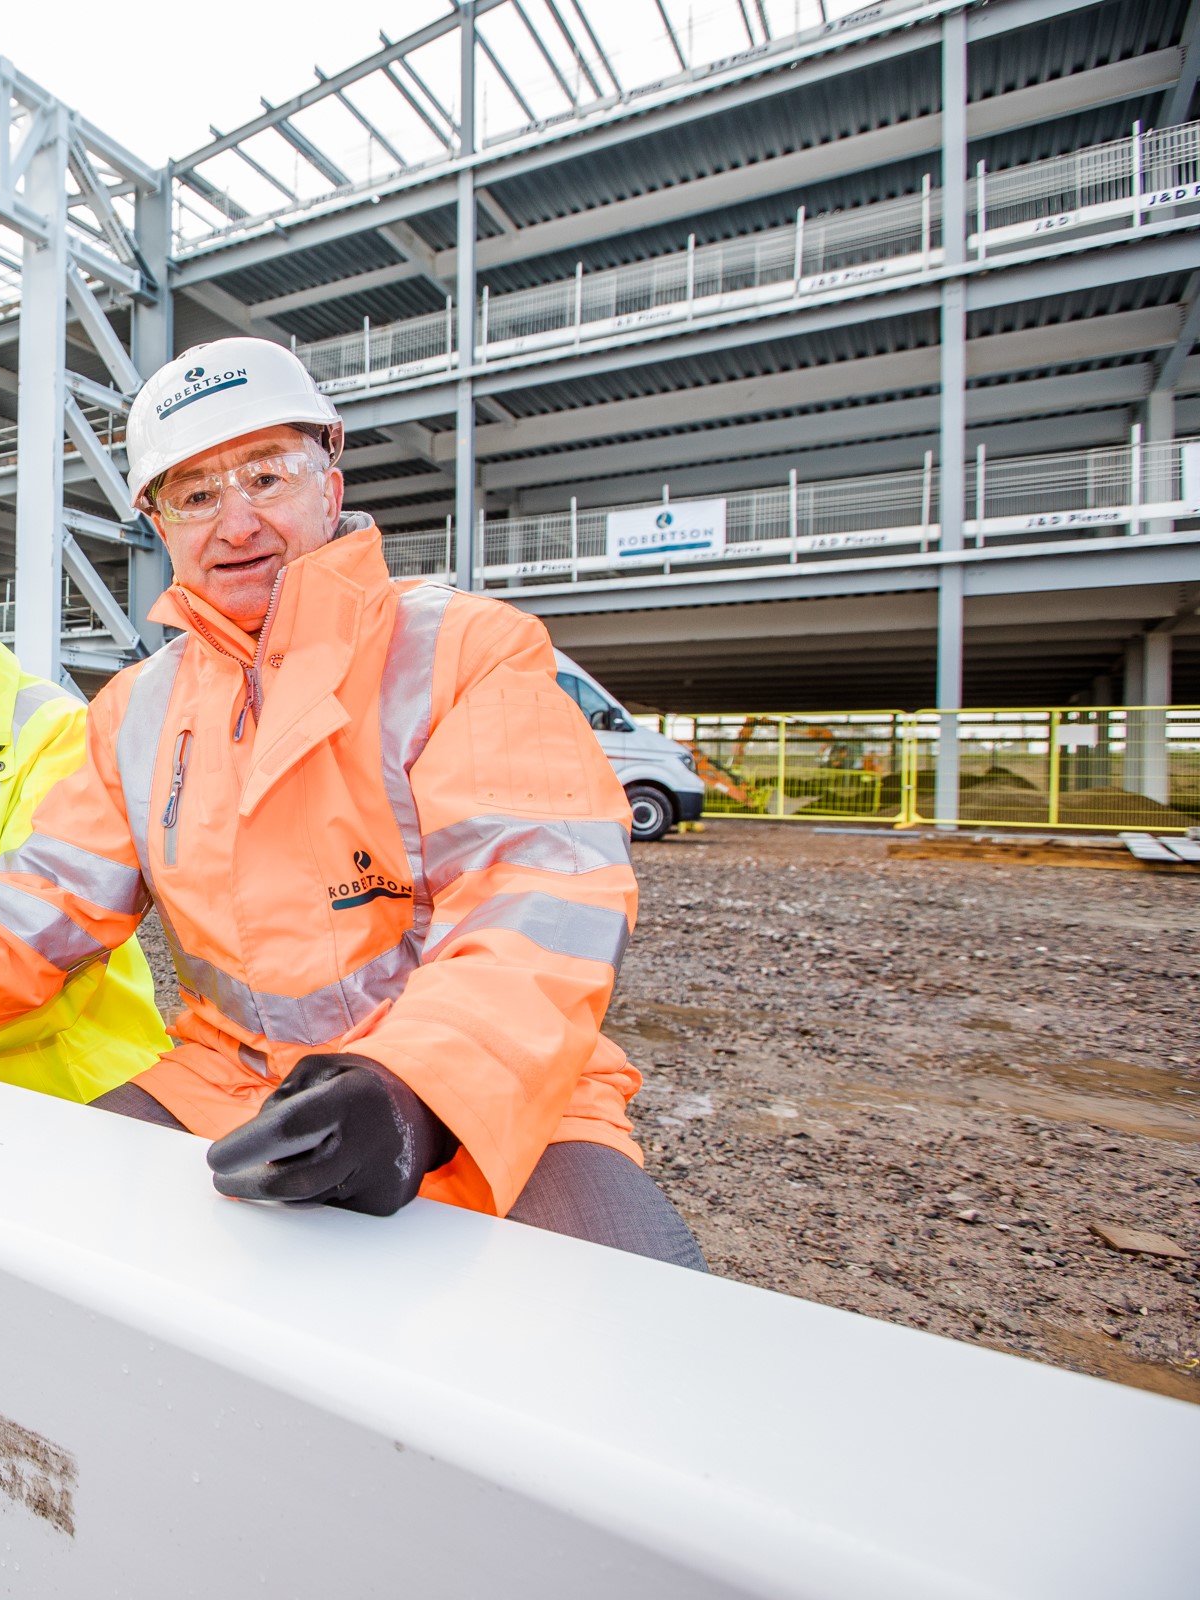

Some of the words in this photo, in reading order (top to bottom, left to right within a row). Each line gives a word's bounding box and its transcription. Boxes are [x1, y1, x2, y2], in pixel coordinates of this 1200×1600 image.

[1149, 189, 1187, 206] J&D
[1034, 216, 1069, 232] J&D
[156, 368, 248, 414] ROBERTSON
[618, 527, 714, 547] ROBERTSON
